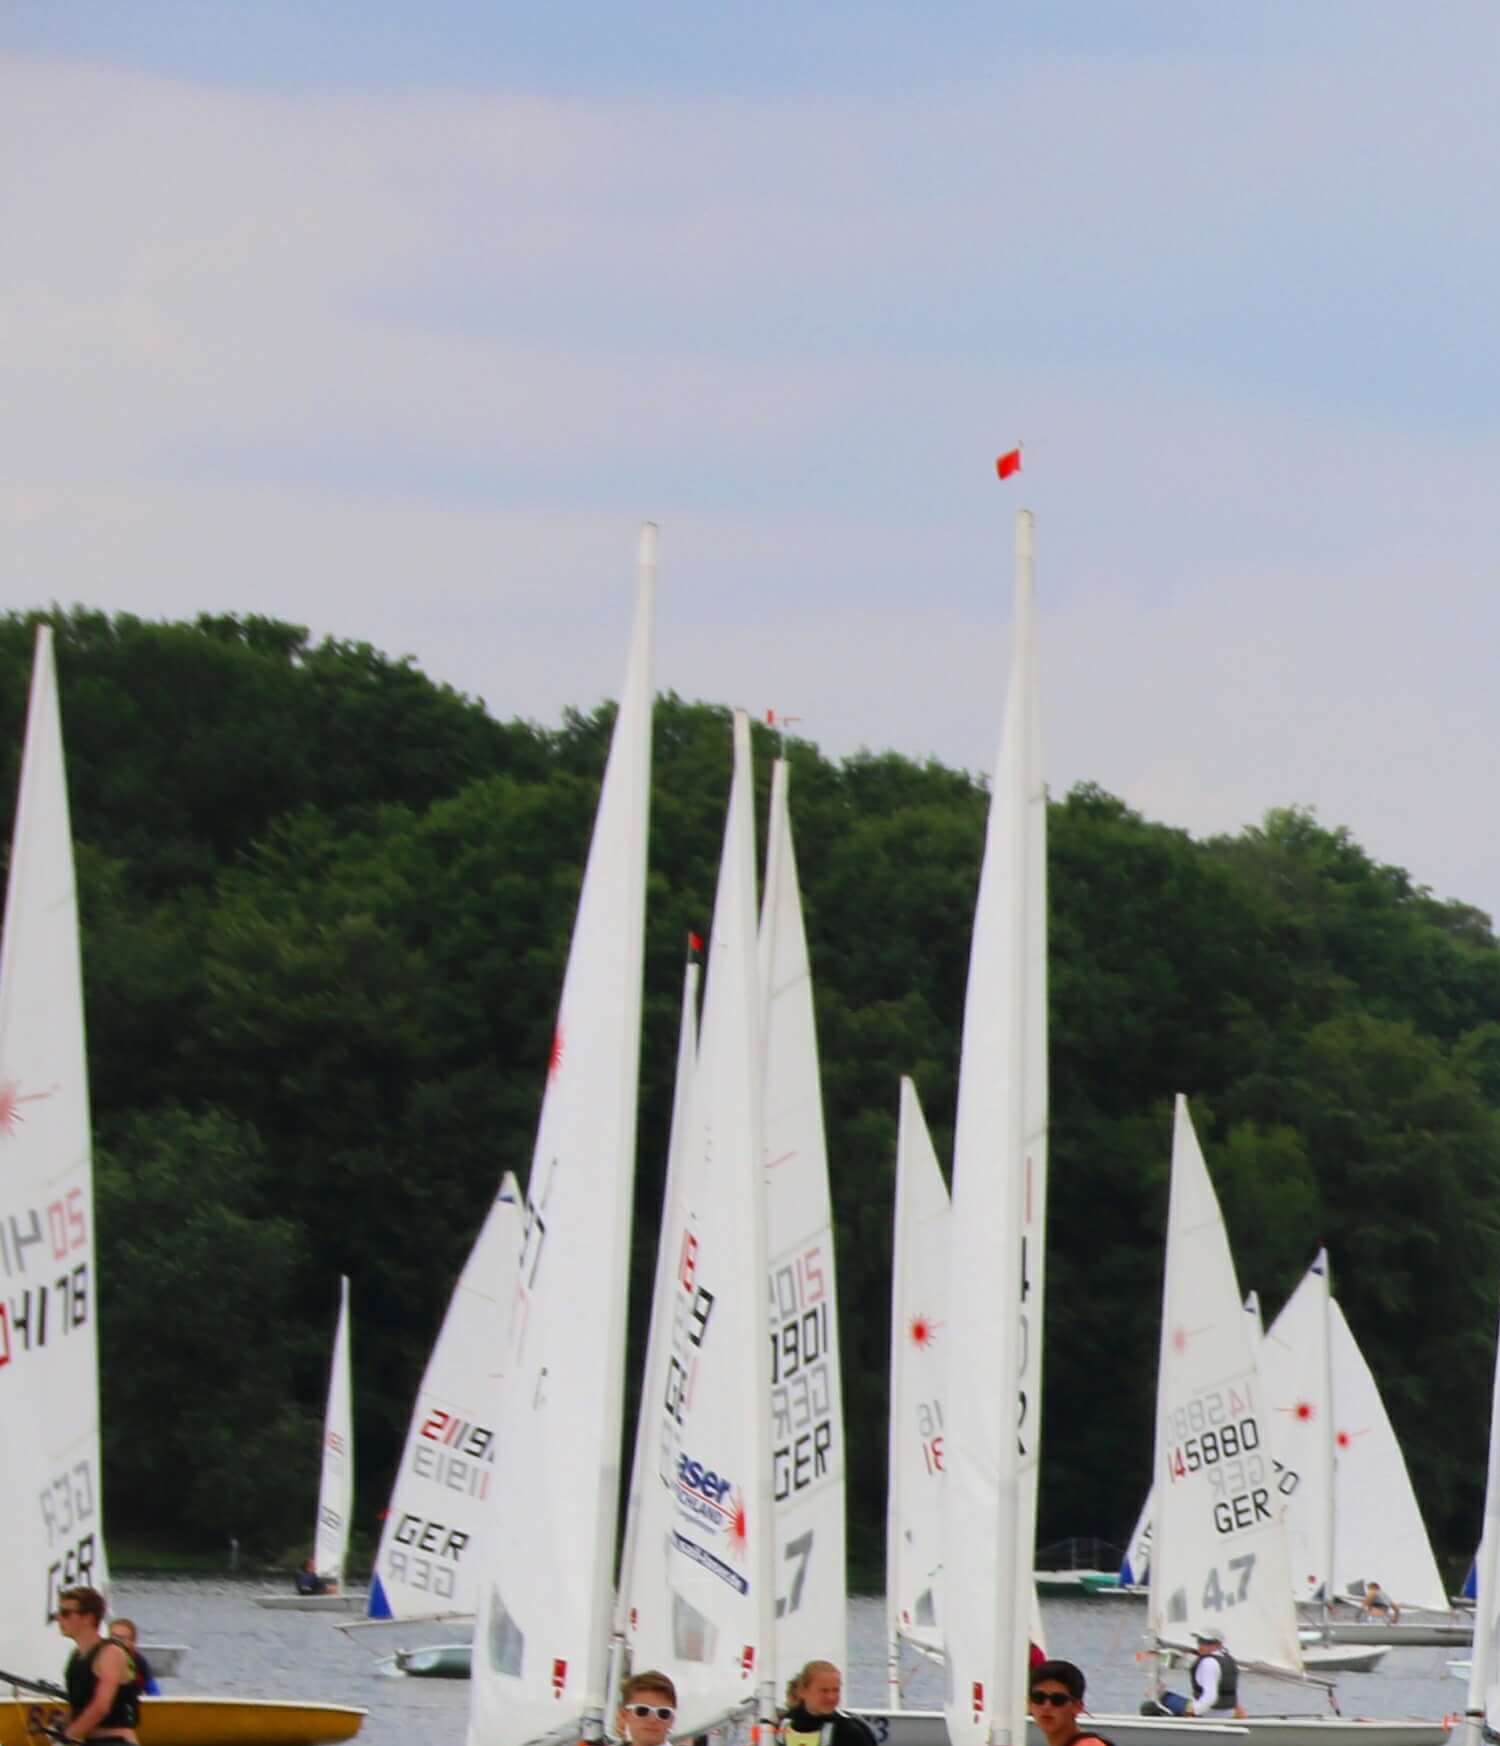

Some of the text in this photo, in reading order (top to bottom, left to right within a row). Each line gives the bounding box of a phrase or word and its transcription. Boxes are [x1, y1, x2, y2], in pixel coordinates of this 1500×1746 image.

[772, 1420, 832, 1502] GER
[1168, 1418, 1260, 1484] 145880
[392, 1513, 471, 1562] GER
[1213, 1487, 1273, 1536] GER
[1202, 1551, 1257, 1612] 4.7
